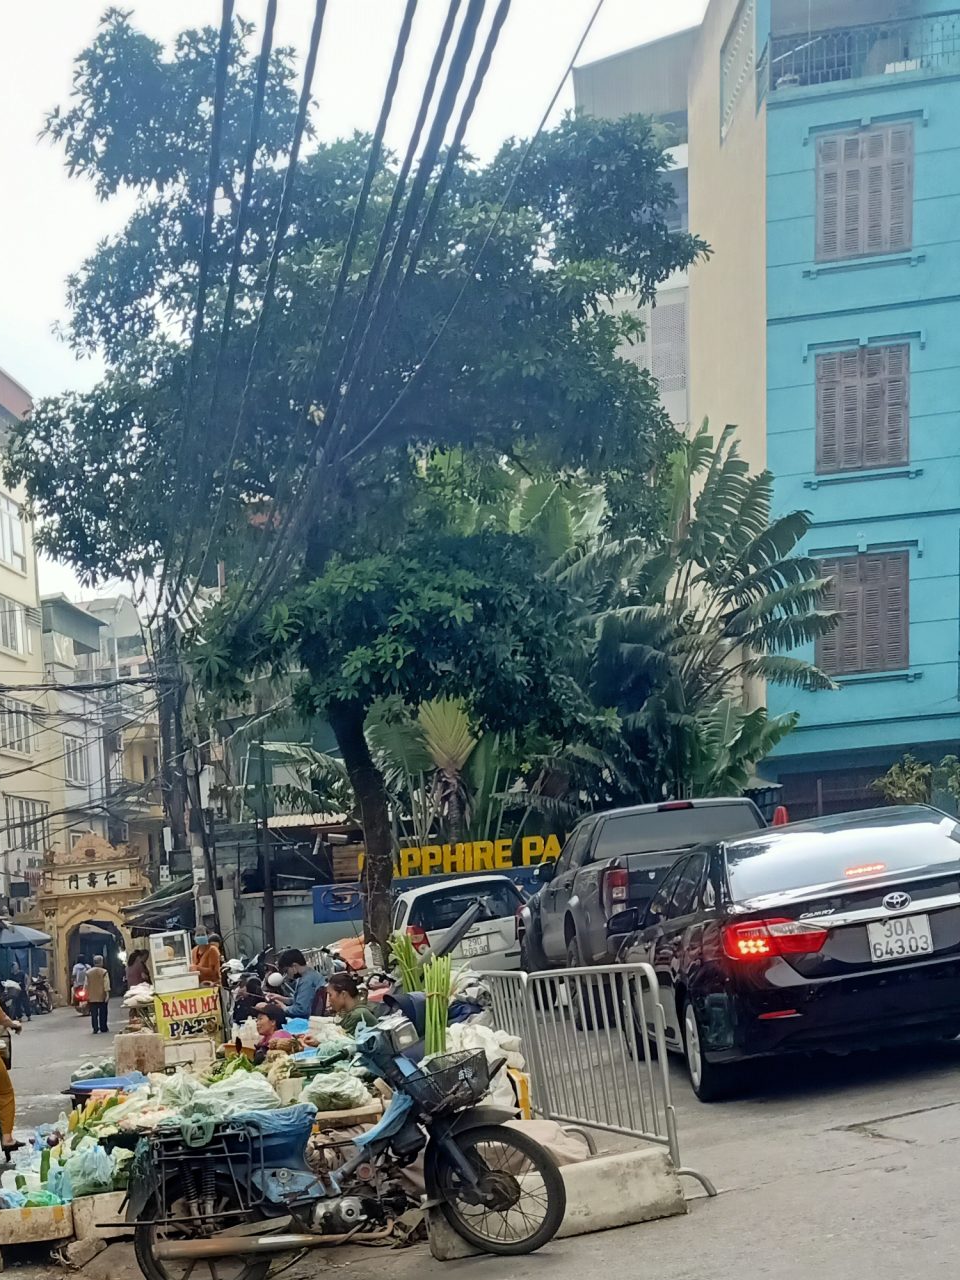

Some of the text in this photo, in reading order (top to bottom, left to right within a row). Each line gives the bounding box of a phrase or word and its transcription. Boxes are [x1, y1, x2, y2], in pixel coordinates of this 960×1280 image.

[883, 918, 916, 938] 30A
[873, 934, 930, 959] 643.03
[162, 996, 198, 1018] BÁNH
